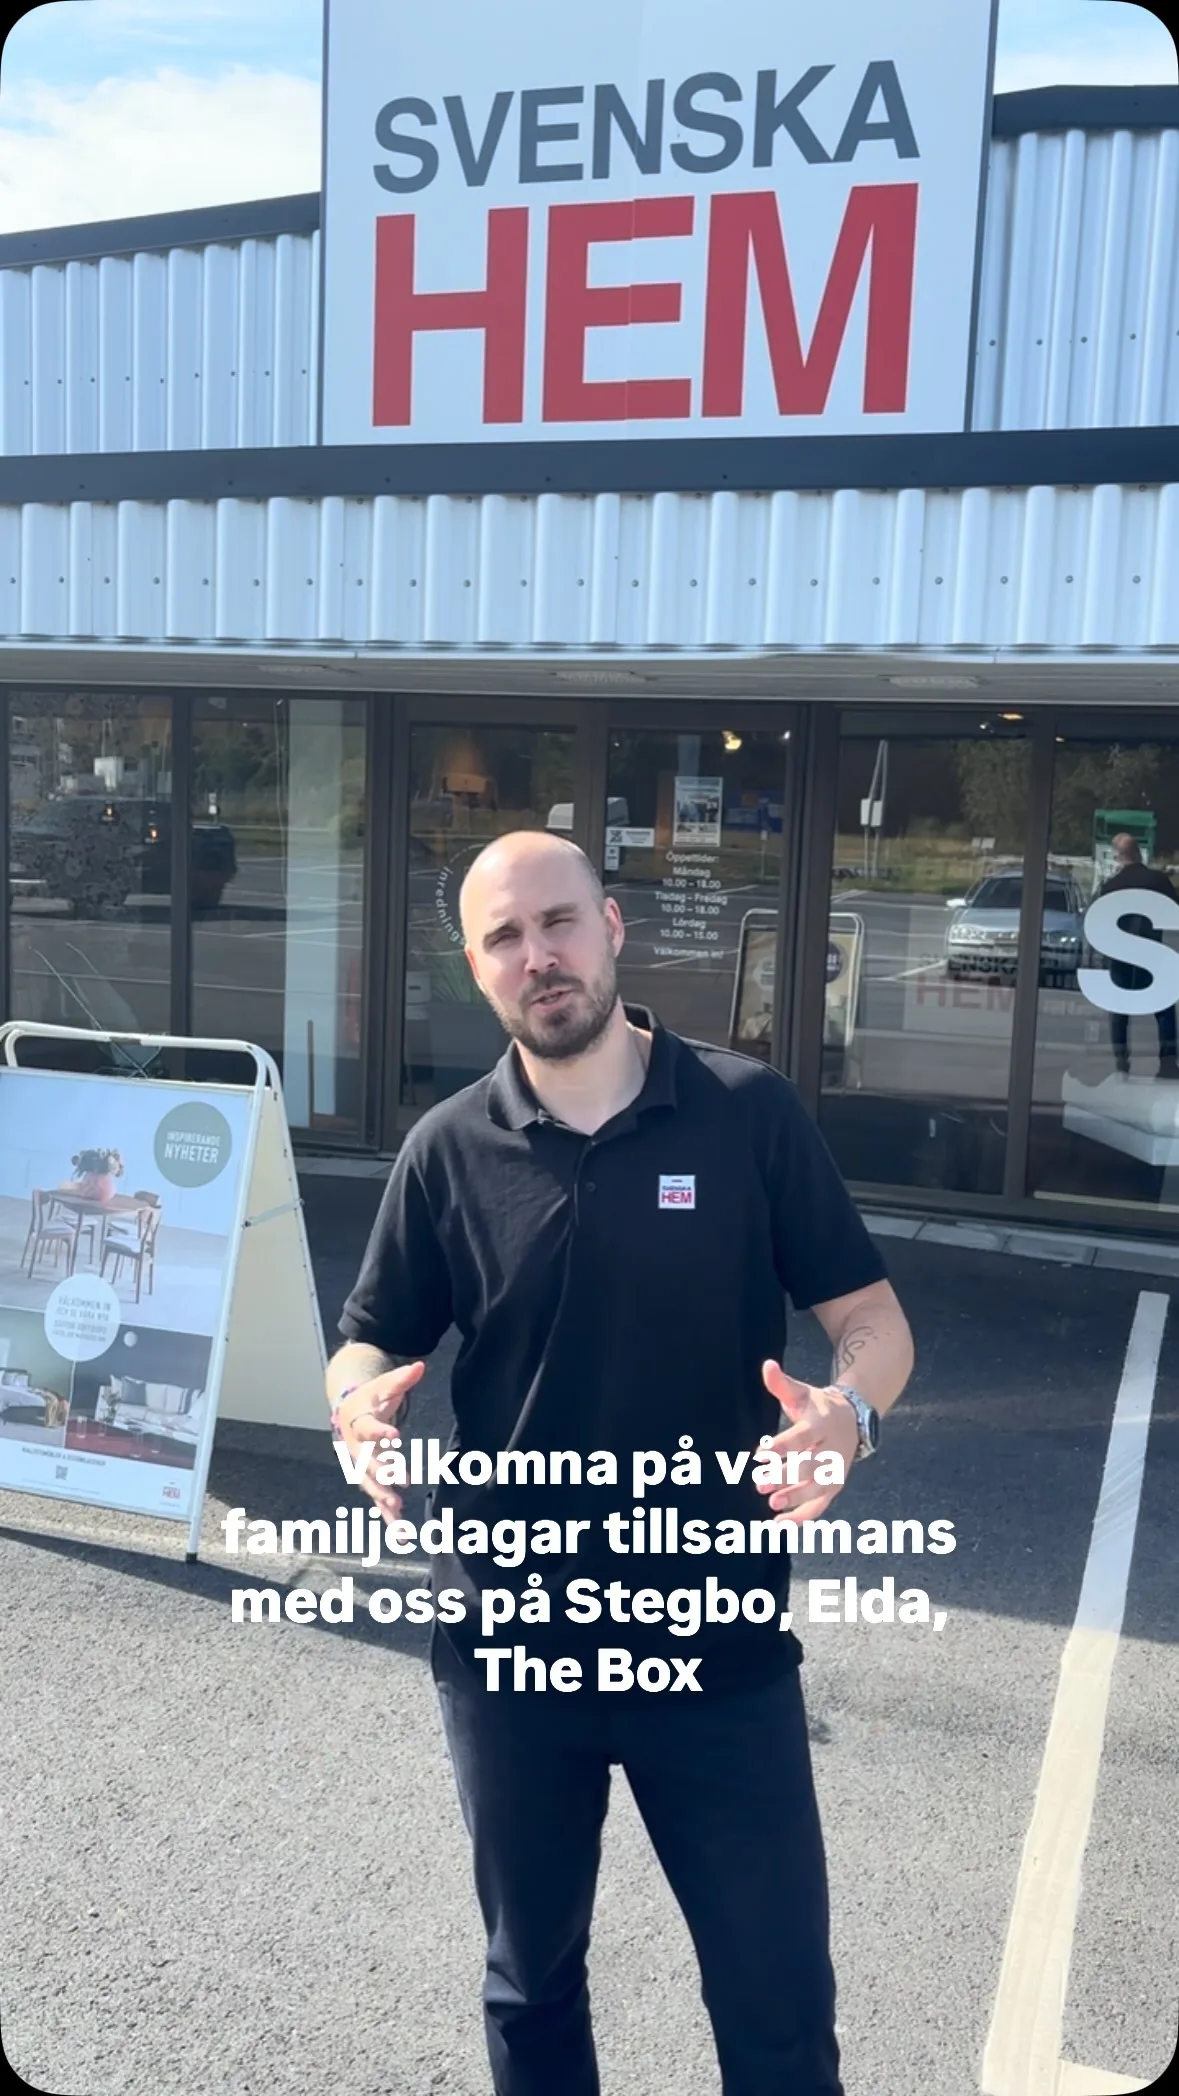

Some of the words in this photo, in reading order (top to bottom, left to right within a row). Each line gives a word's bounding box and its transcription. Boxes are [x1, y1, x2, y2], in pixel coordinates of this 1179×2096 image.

[373, 60, 920, 193] SVENSKA
[372, 182, 919, 427] HEM
[672, 866, 711, 879] Måndag
[662, 878, 687, 888] 10.00
[655, 891, 686, 903] Tisdag
[694, 893, 728, 905] Fredag
[661, 904, 685, 913] 10.00
[672, 918, 706, 930] Lördag
[660, 929, 684, 938] 10.00
[653, 946, 709, 958] Välkommen
[164, 1143, 219, 1164] NYHETER
[662, 1192, 692, 1203] HEM
